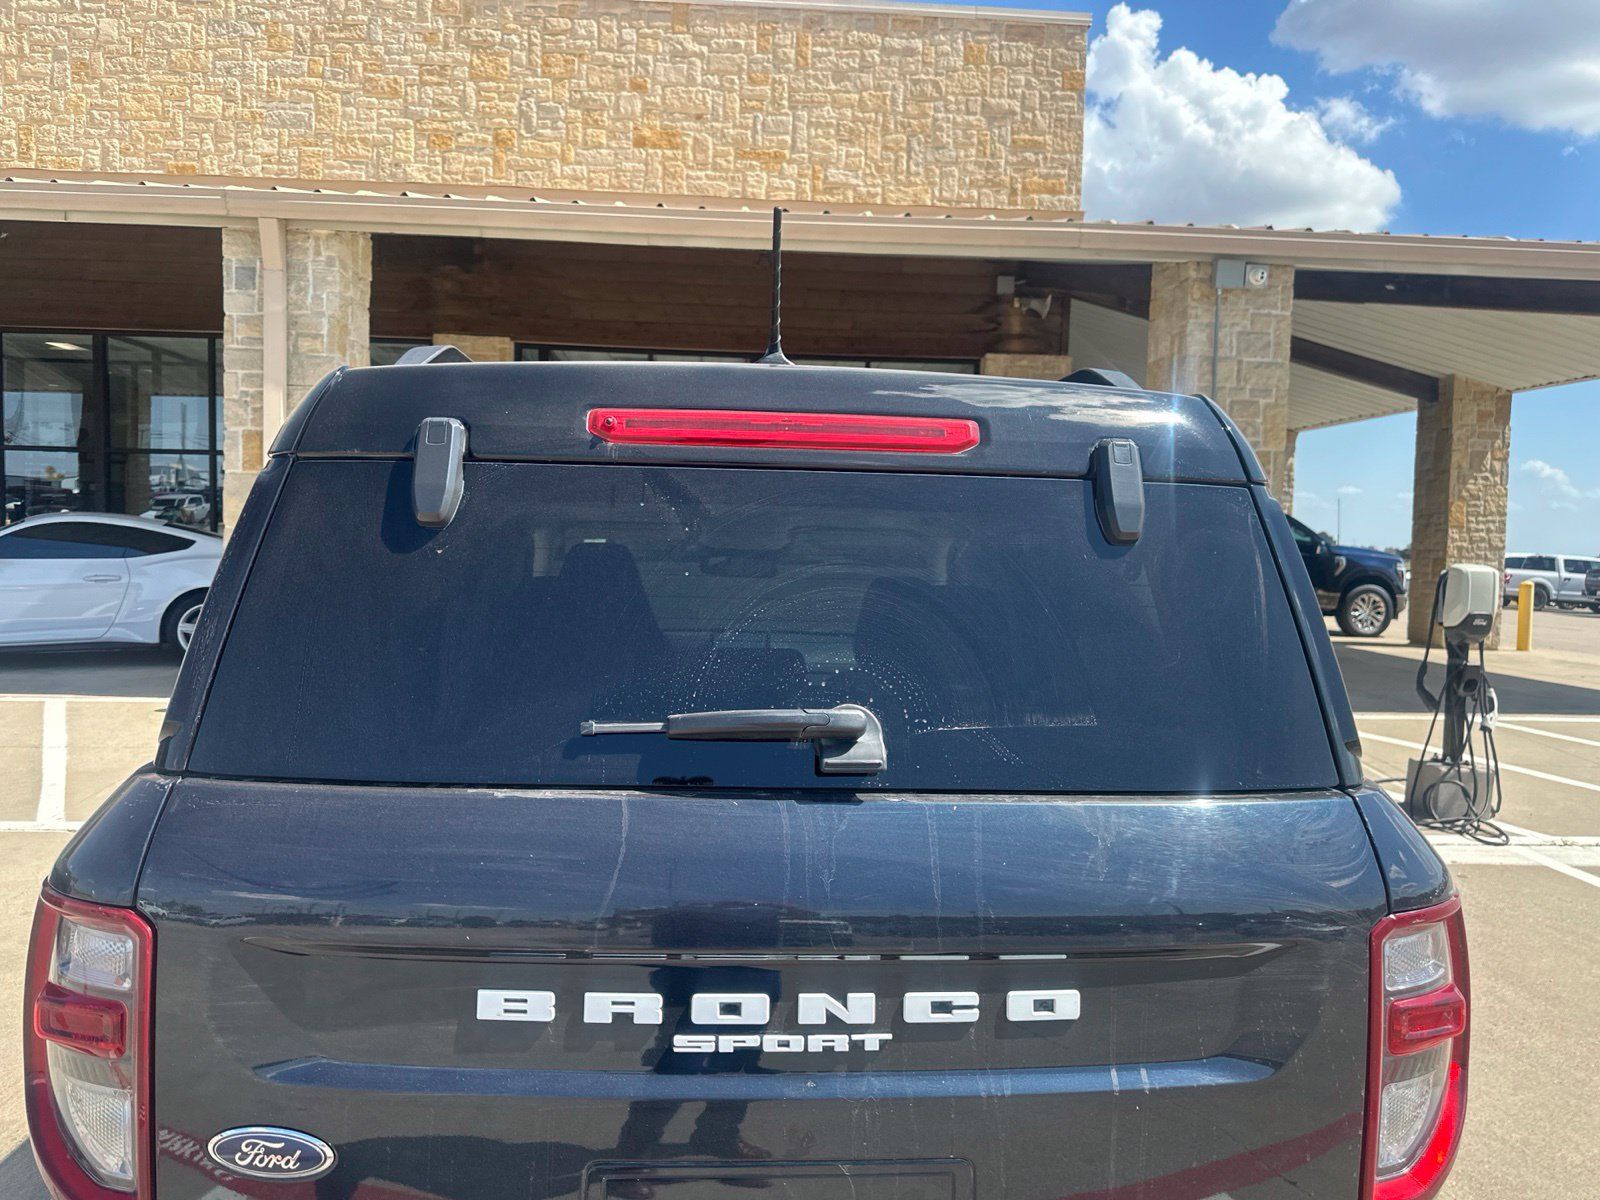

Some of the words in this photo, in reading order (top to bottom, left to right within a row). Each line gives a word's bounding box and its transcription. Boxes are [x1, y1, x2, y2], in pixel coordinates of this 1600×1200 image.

[476, 989, 1081, 1025] BRONCO
[672, 1032, 893, 1053] SPORT
[234, 1138, 302, 1170] Ford
